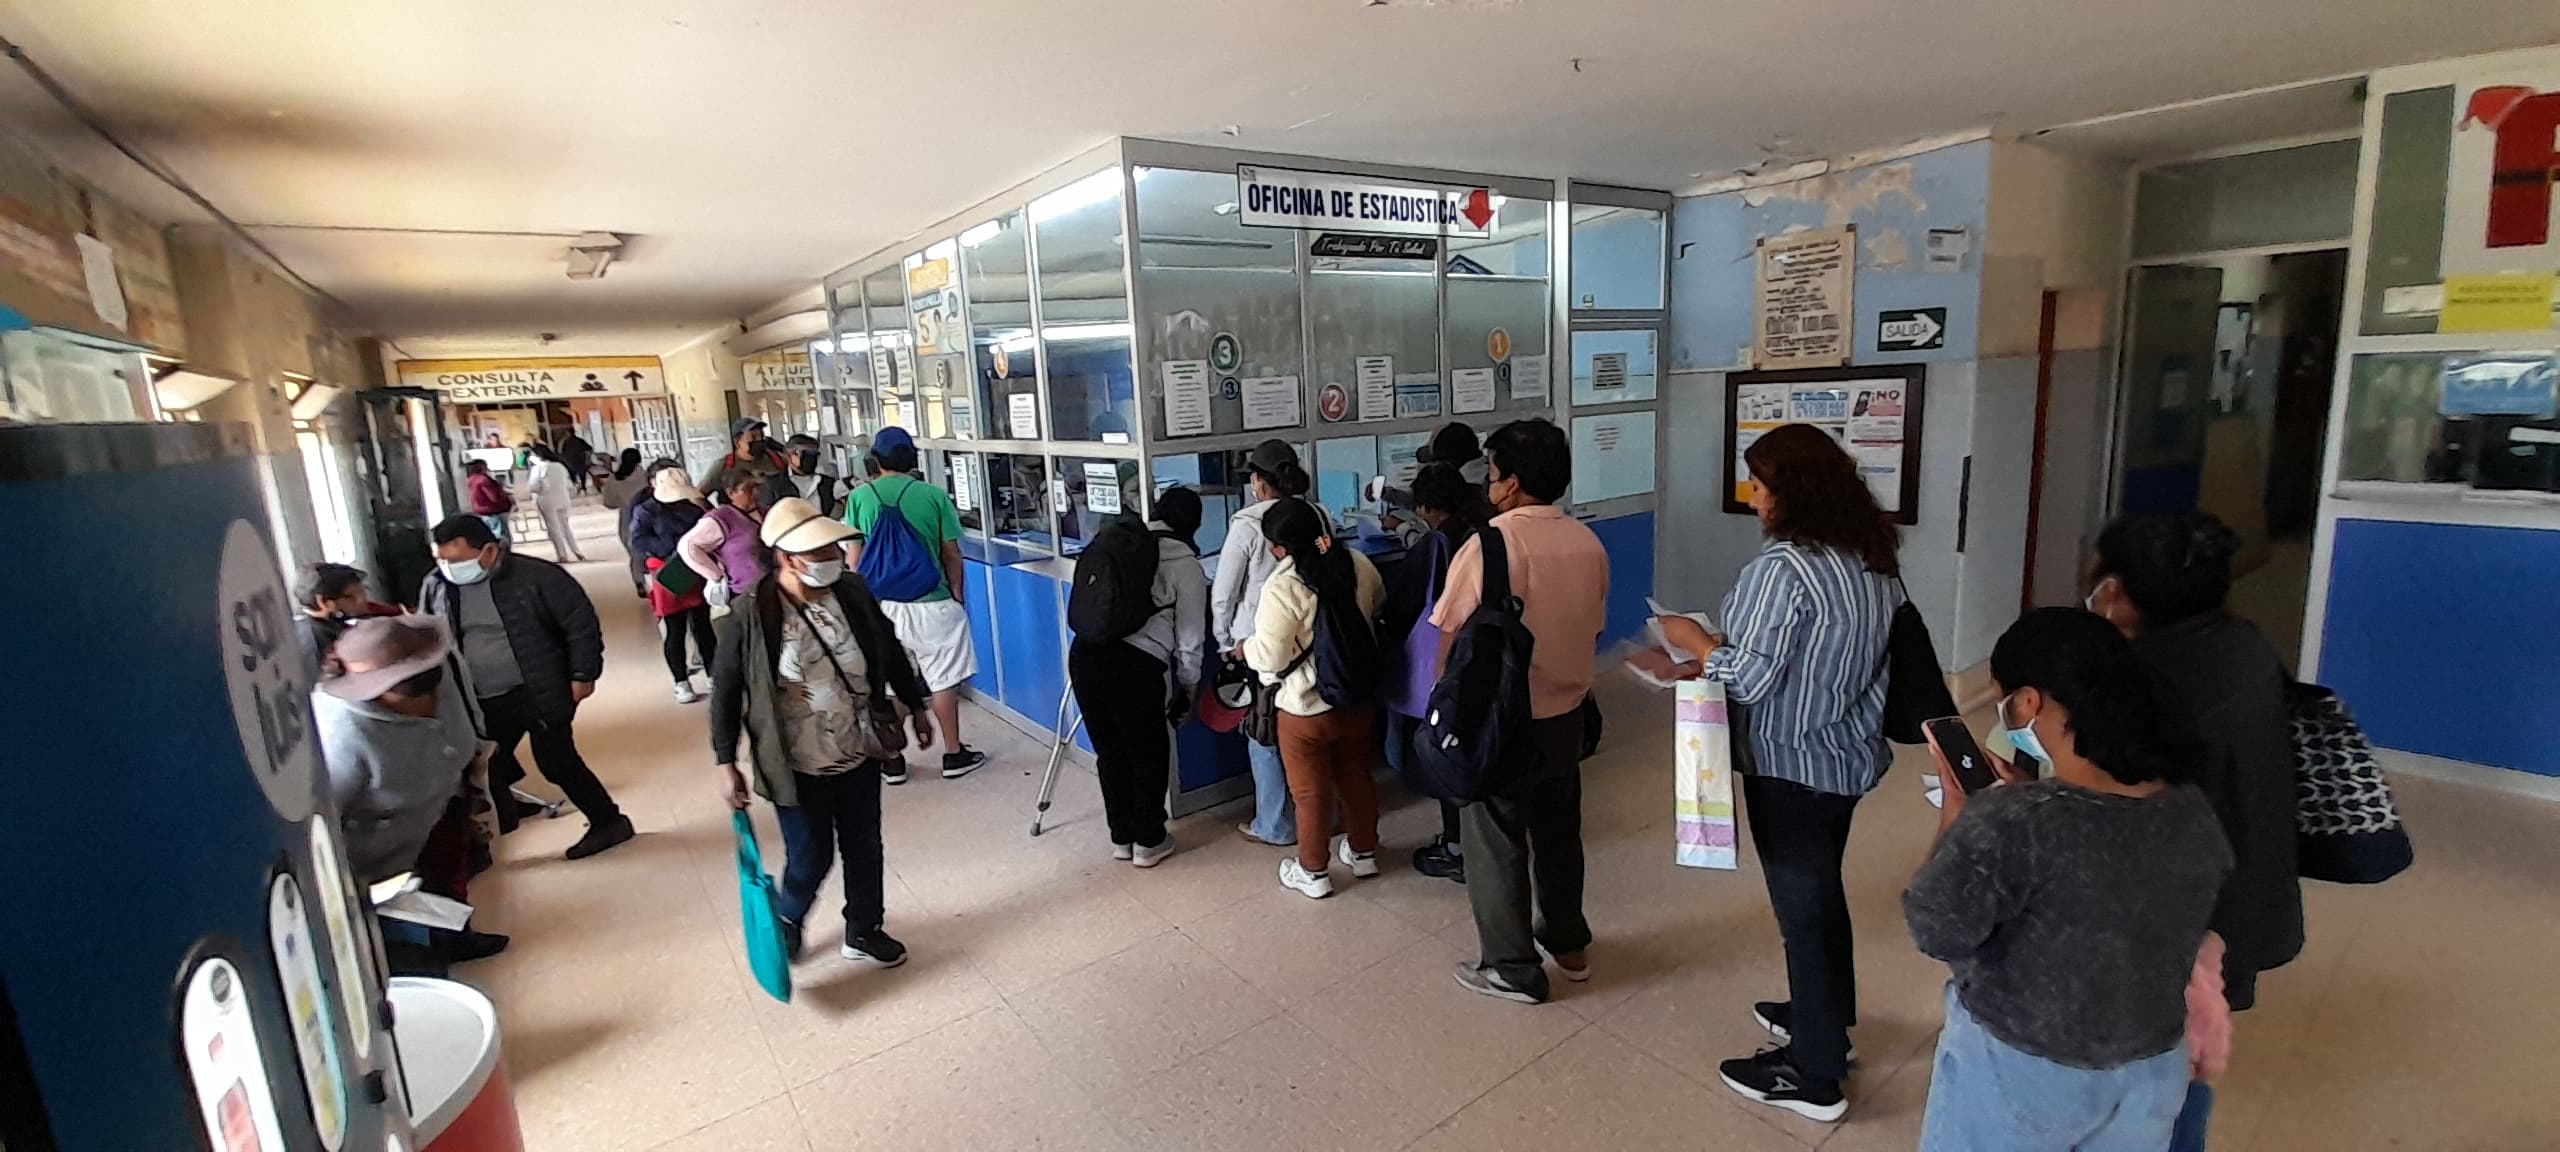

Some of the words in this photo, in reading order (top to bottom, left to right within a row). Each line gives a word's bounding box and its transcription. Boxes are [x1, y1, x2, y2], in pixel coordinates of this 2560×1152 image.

[1247, 183, 1325, 216] OFICINA
[1331, 189, 1354, 218] DE
[1360, 192, 1458, 225] ESTADISTICA
[1886, 323, 1929, 338] SALIDA
[1217, 339, 1232, 365] 3
[1492, 331, 1504, 353] 1
[437, 371, 554, 386] CONSULTA
[1224, 378, 1236, 396] 3
[451, 384, 551, 399] EXTERNA
[1327, 389, 1340, 412] 2
